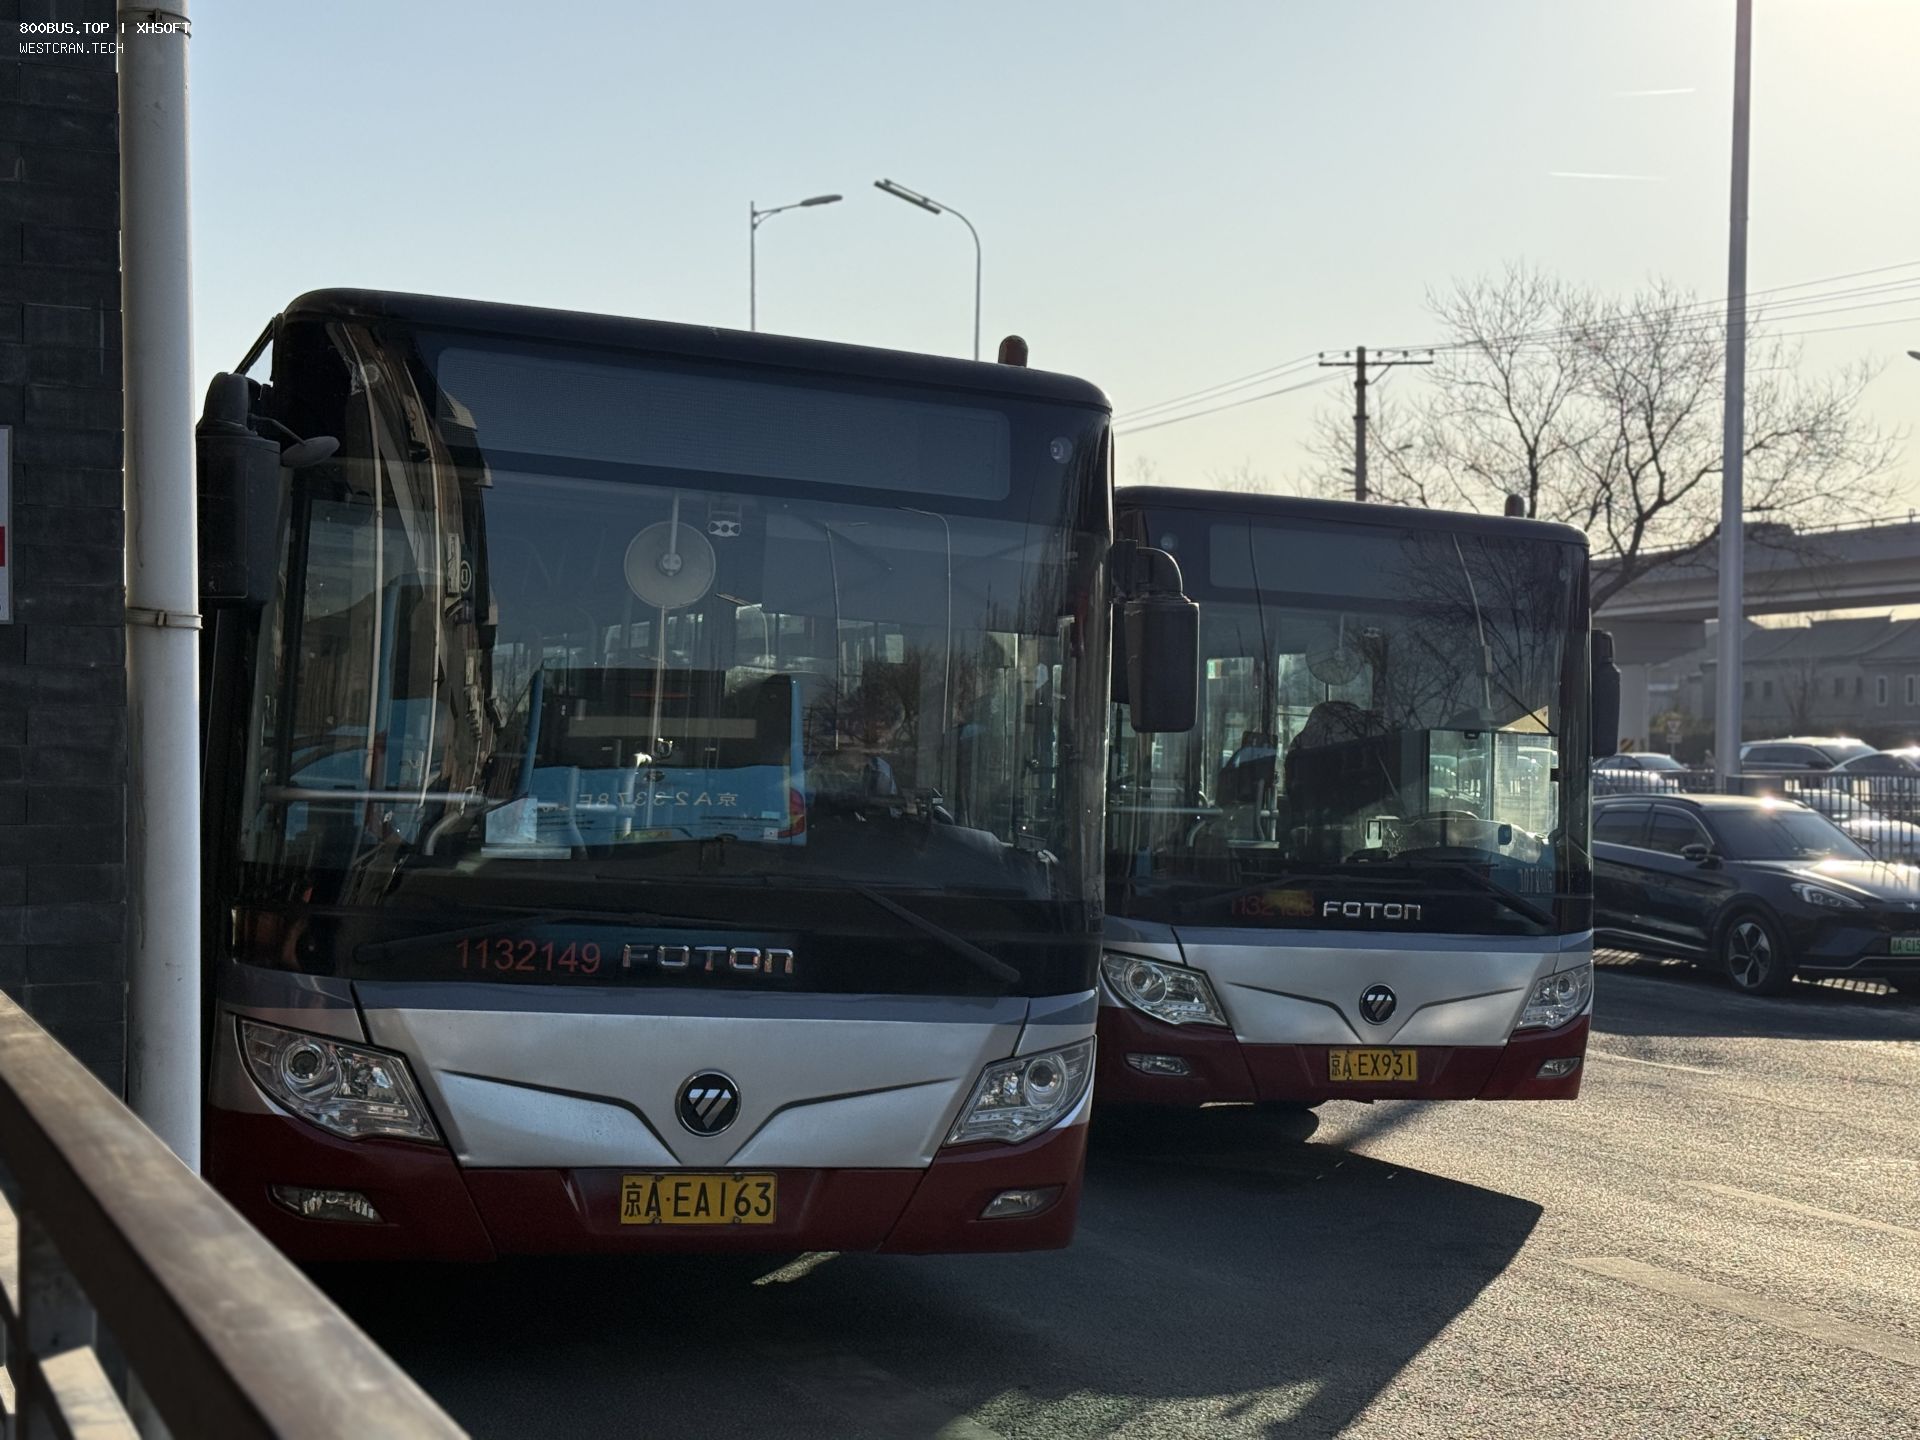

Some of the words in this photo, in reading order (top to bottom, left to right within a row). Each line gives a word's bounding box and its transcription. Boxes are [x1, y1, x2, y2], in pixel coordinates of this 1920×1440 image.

[1322, 901, 1421, 920] FOTON
[456, 938, 600, 974] 1132149
[622, 944, 793, 974] FOTON
